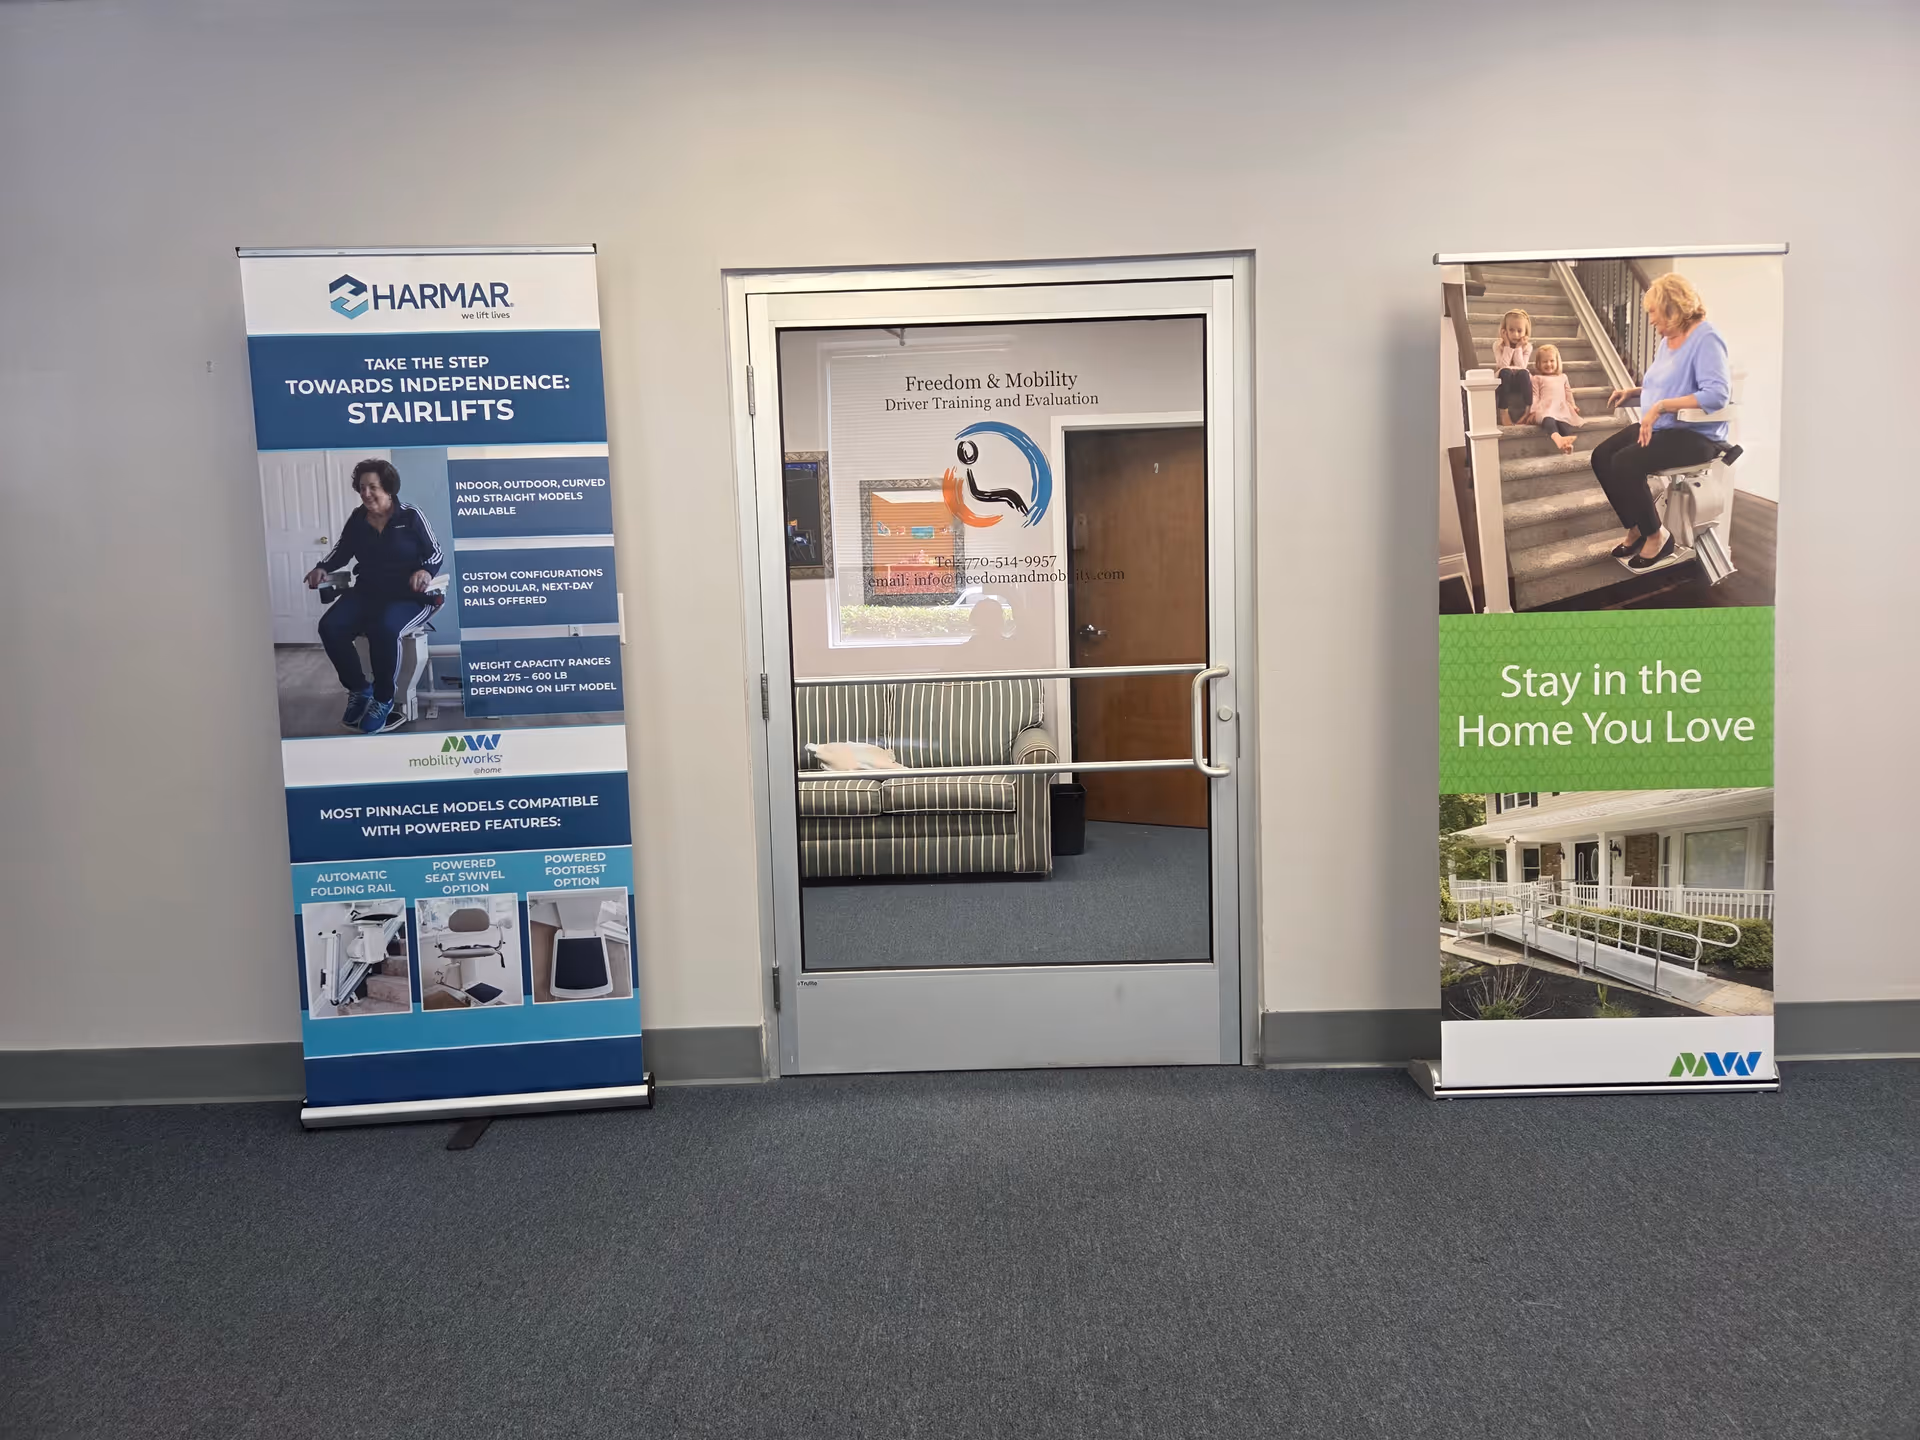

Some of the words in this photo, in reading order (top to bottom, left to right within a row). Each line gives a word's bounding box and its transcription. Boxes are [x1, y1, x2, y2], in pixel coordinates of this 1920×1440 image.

[372, 282, 510, 310] HARMAR
[476, 311, 489, 319] lift
[491, 311, 510, 319] lives
[364, 358, 407, 371] TAKE
[411, 357, 444, 370] THE
[448, 356, 489, 369] STEP
[285, 378, 394, 395] TOWARDS
[400, 375, 570, 393] INDEPENDENCE:
[905, 374, 981, 392] Freedom
[986, 373, 1000, 389] &
[1005, 370, 1078, 390] Mobility
[885, 398, 928, 412] Driver
[931, 396, 992, 411] Training
[995, 394, 1021, 408] and
[1025, 392, 1099, 407] Evaluation
[348, 399, 514, 424] STAIRLIFTS
[456, 480, 502, 490] INDOOR,
[503, 480, 560, 489] OUTDOOR,
[562, 478, 606, 488] CURVED
[456, 494, 480, 503] AND
[483, 492, 536, 502] STRAIGHT
[538, 492, 583, 501] MODELS
[458, 506, 516, 516] AVAILABLE
[934, 555, 960, 568] Tel:
[965, 554, 1057, 570] 770-514-9957
[462, 571, 507, 581] CUSTOM
[510, 568, 604, 580] CONFIGURATIONS
[868, 574, 910, 588] email:
[463, 585, 479, 594] OR
[482, 583, 539, 593] MODULAR,
[542, 582, 594, 592] NEXT-DAY
[464, 598, 496, 606] RAILS
[498, 596, 547, 606] OFFERED
[468, 660, 512, 670] WEIGHT
[514, 658, 566, 669] CAPACITY
[568, 657, 611, 667] RANGES
[470, 674, 500, 683] FROM
[503, 673, 521, 682] 275
[532, 672, 552, 681] 600
[554, 671, 568, 680] LB
[1500, 664, 1582, 706] Stay
[1594, 663, 1626, 696] in
[1638, 660, 1702, 694] the
[470, 686, 533, 696] DEPENDING
[536, 684, 552, 694] ON
[555, 684, 576, 692] LIFT
[579, 682, 617, 692] MODEL
[1458, 714, 1574, 748] Home
[1581, 712, 1652, 745] You
[1667, 710, 1756, 744] Love
[474, 767, 502, 775] @home
[320, 807, 362, 820] MOST
[366, 803, 438, 818] PINNACLE
[443, 800, 504, 814] MODELS
[508, 795, 599, 810] COMPATIBLE
[362, 824, 400, 837] WITH
[404, 820, 480, 835] POWERED
[485, 816, 562, 831] FEATURES:
[432, 858, 496, 870] POWERED
[544, 852, 606, 864] POWERED
[425, 872, 455, 883] SEAT
[458, 870, 505, 881] SWIVEL
[545, 864, 606, 876] FOOTREST
[316, 870, 388, 884] AUTOMATIC
[554, 876, 600, 888] OPTION
[310, 884, 364, 896] FOLDING
[368, 883, 396, 894] RAIL
[442, 883, 489, 894] OPTION
